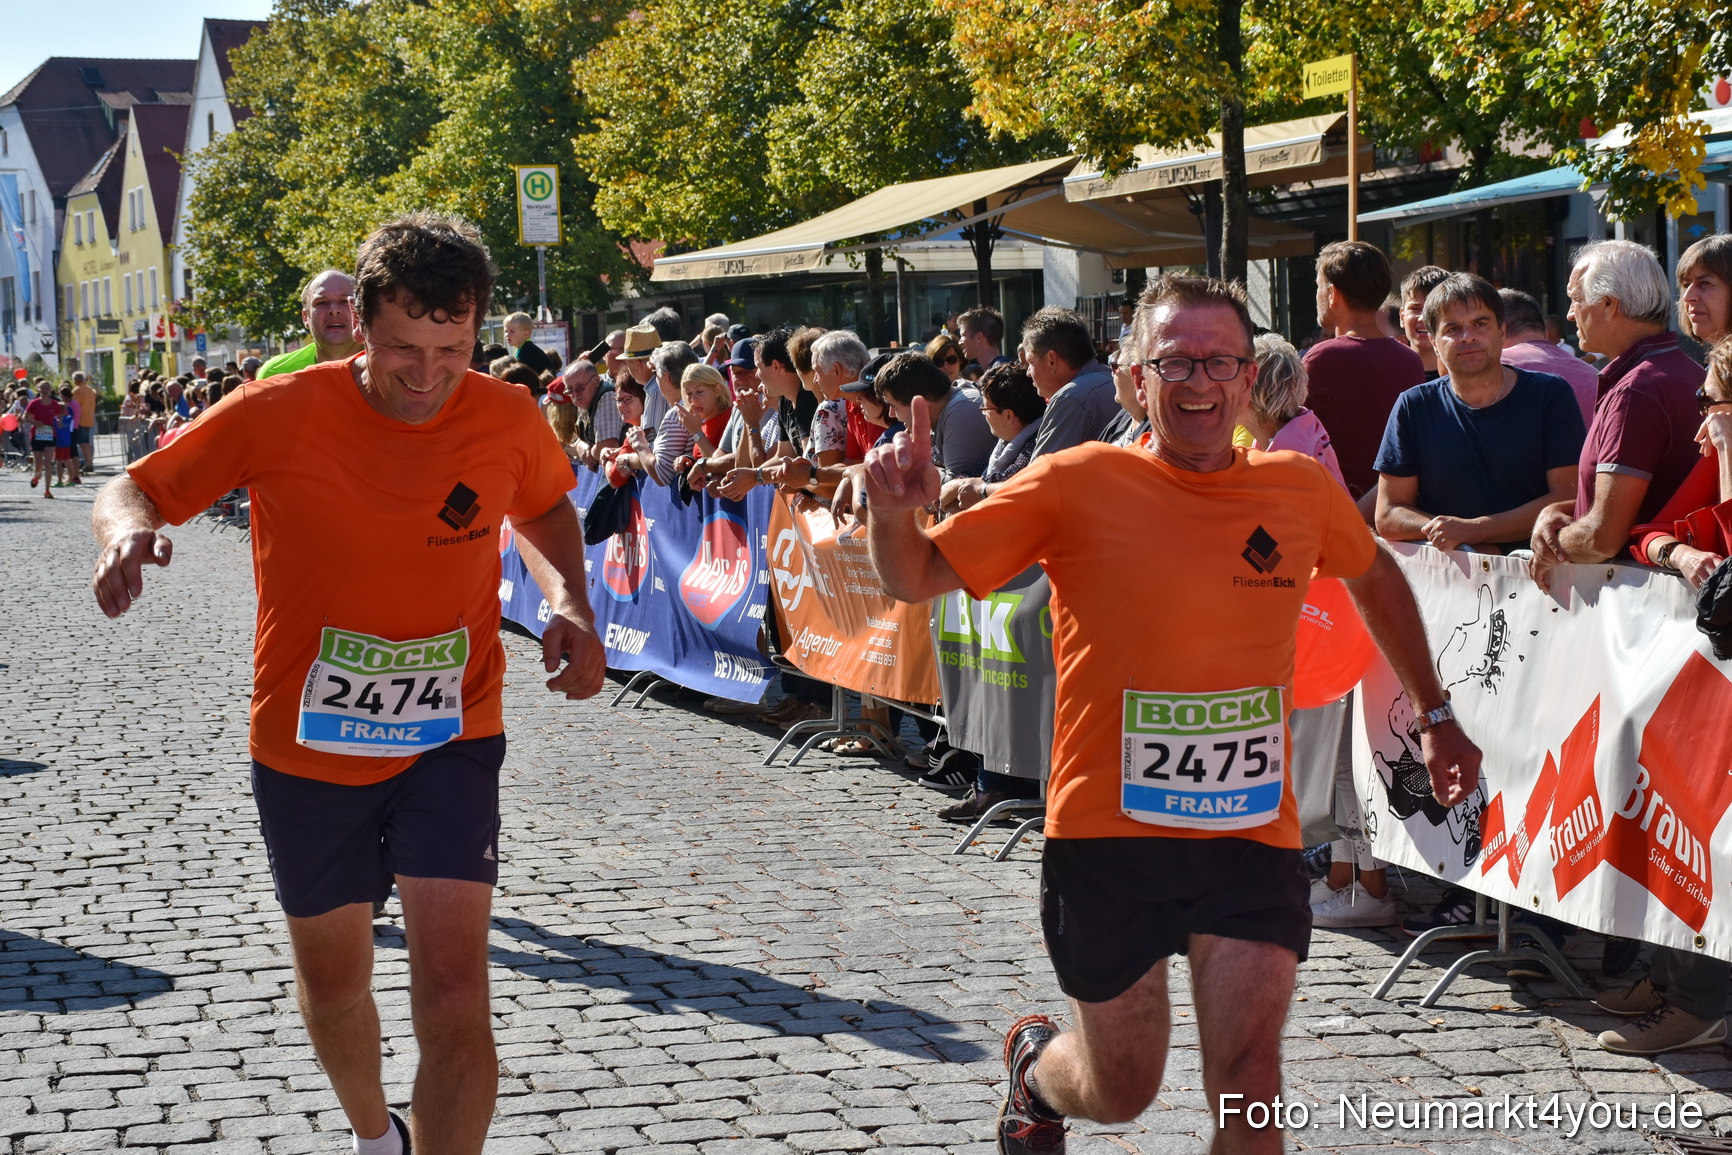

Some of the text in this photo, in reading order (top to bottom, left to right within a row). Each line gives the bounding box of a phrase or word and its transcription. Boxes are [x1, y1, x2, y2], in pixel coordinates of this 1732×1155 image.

[1312, 69, 1349, 88] Toiletten
[531, 178, 546, 195] H
[427, 525, 491, 547] FliesenEichl
[684, 539, 748, 604] Hervis
[1233, 576, 1296, 588] FliesenEichl
[331, 635, 456, 671] BOCK
[796, 626, 843, 659] Agentur
[714, 651, 731, 678] GET
[322, 674, 443, 716] 2474
[1137, 690, 1272, 731] BOCK
[340, 720, 422, 742] FRANZ
[1143, 735, 1268, 783] 2475
[1165, 794, 1249, 815] FRANZ
[1549, 795, 1599, 867] Braun
[1616, 762, 1708, 884] Braun
[1569, 846, 1587, 867] Sicher
[1585, 839, 1594, 855] ist
[1648, 847, 1713, 910] Sicher ist sicher
